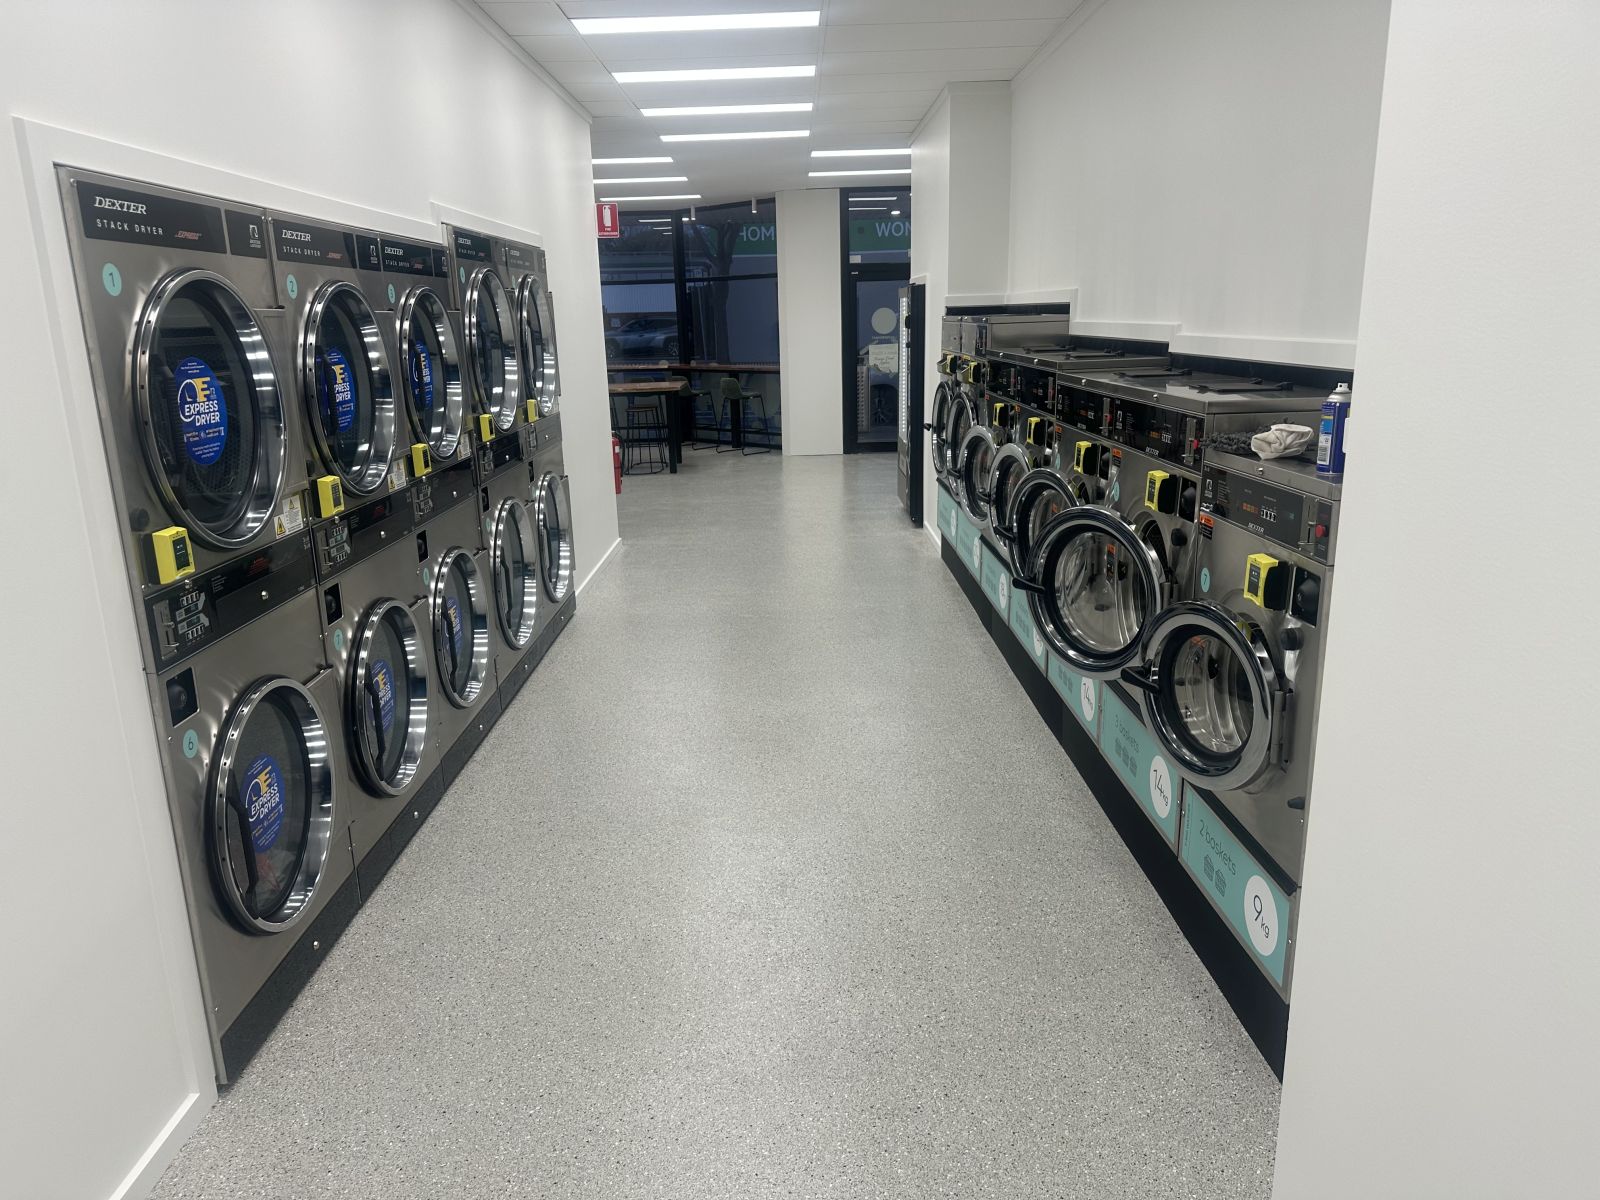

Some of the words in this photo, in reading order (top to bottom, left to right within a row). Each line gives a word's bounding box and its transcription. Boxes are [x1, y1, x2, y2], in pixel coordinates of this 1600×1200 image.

[94, 196, 147, 215] DEXTER
[97, 218, 129, 231] STACK
[135, 224, 164, 236] DRYER
[282, 229, 311, 242] DEXTER
[384, 246, 404, 256] DEXTER
[289, 280, 295, 293] 2
[333, 382, 350, 394] PRESS
[184, 400, 218, 416] EXPRESS
[195, 412, 220, 427] DRYER
[187, 738, 194, 751] 6
[251, 782, 279, 816] EXPRESS
[259, 792, 280, 819] DRYER
[1199, 819, 1205, 839] 2
[1205, 824, 1237, 876] baskets
